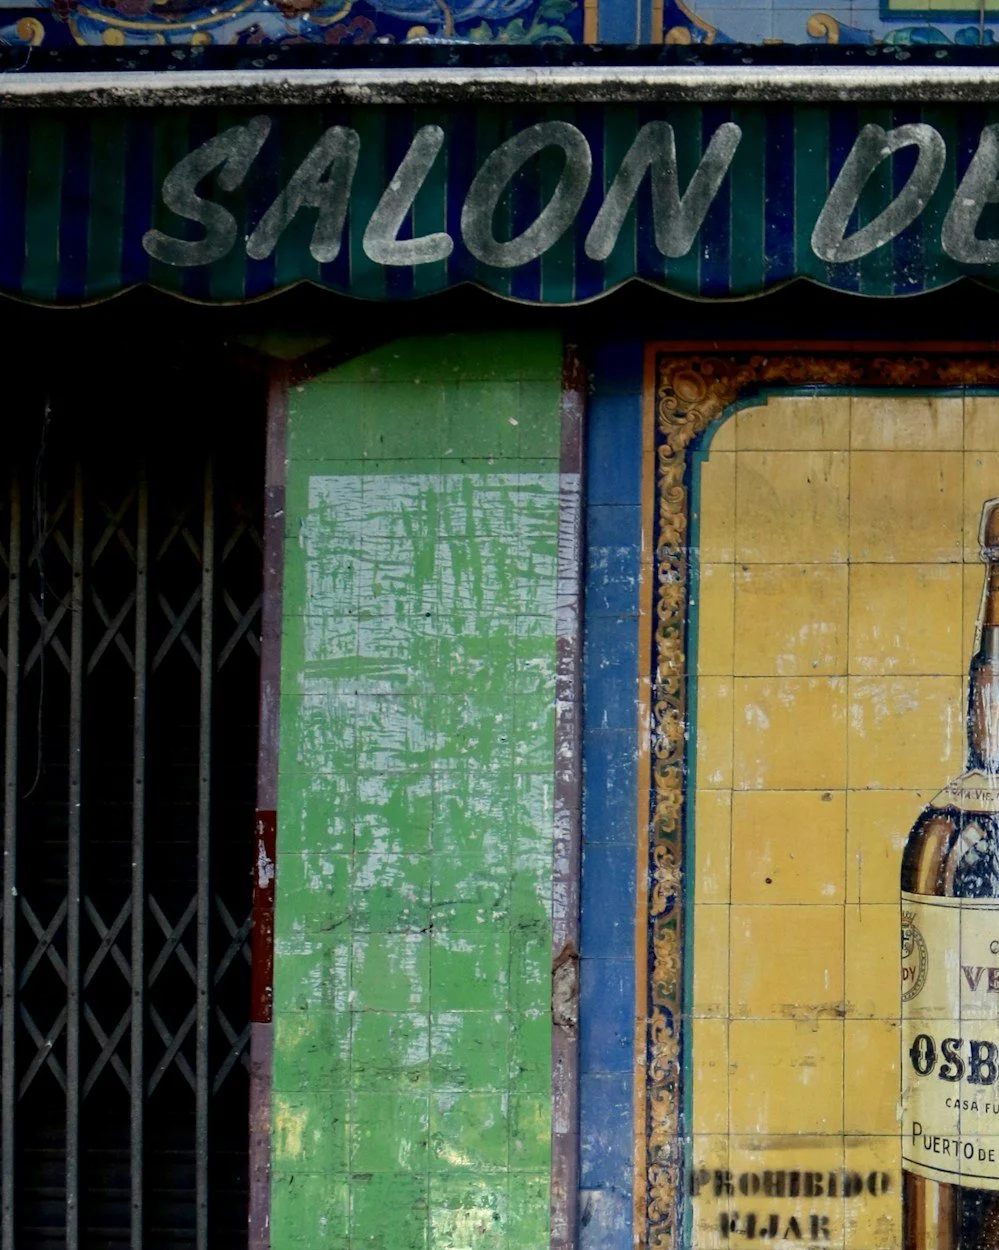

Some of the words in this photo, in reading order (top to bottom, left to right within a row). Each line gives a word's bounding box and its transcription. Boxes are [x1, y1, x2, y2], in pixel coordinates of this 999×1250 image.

[142, 115, 742, 268] SALON
[945, 1097, 979, 1112] CASA
[689, 1168, 890, 1197] PROHIBIDO
